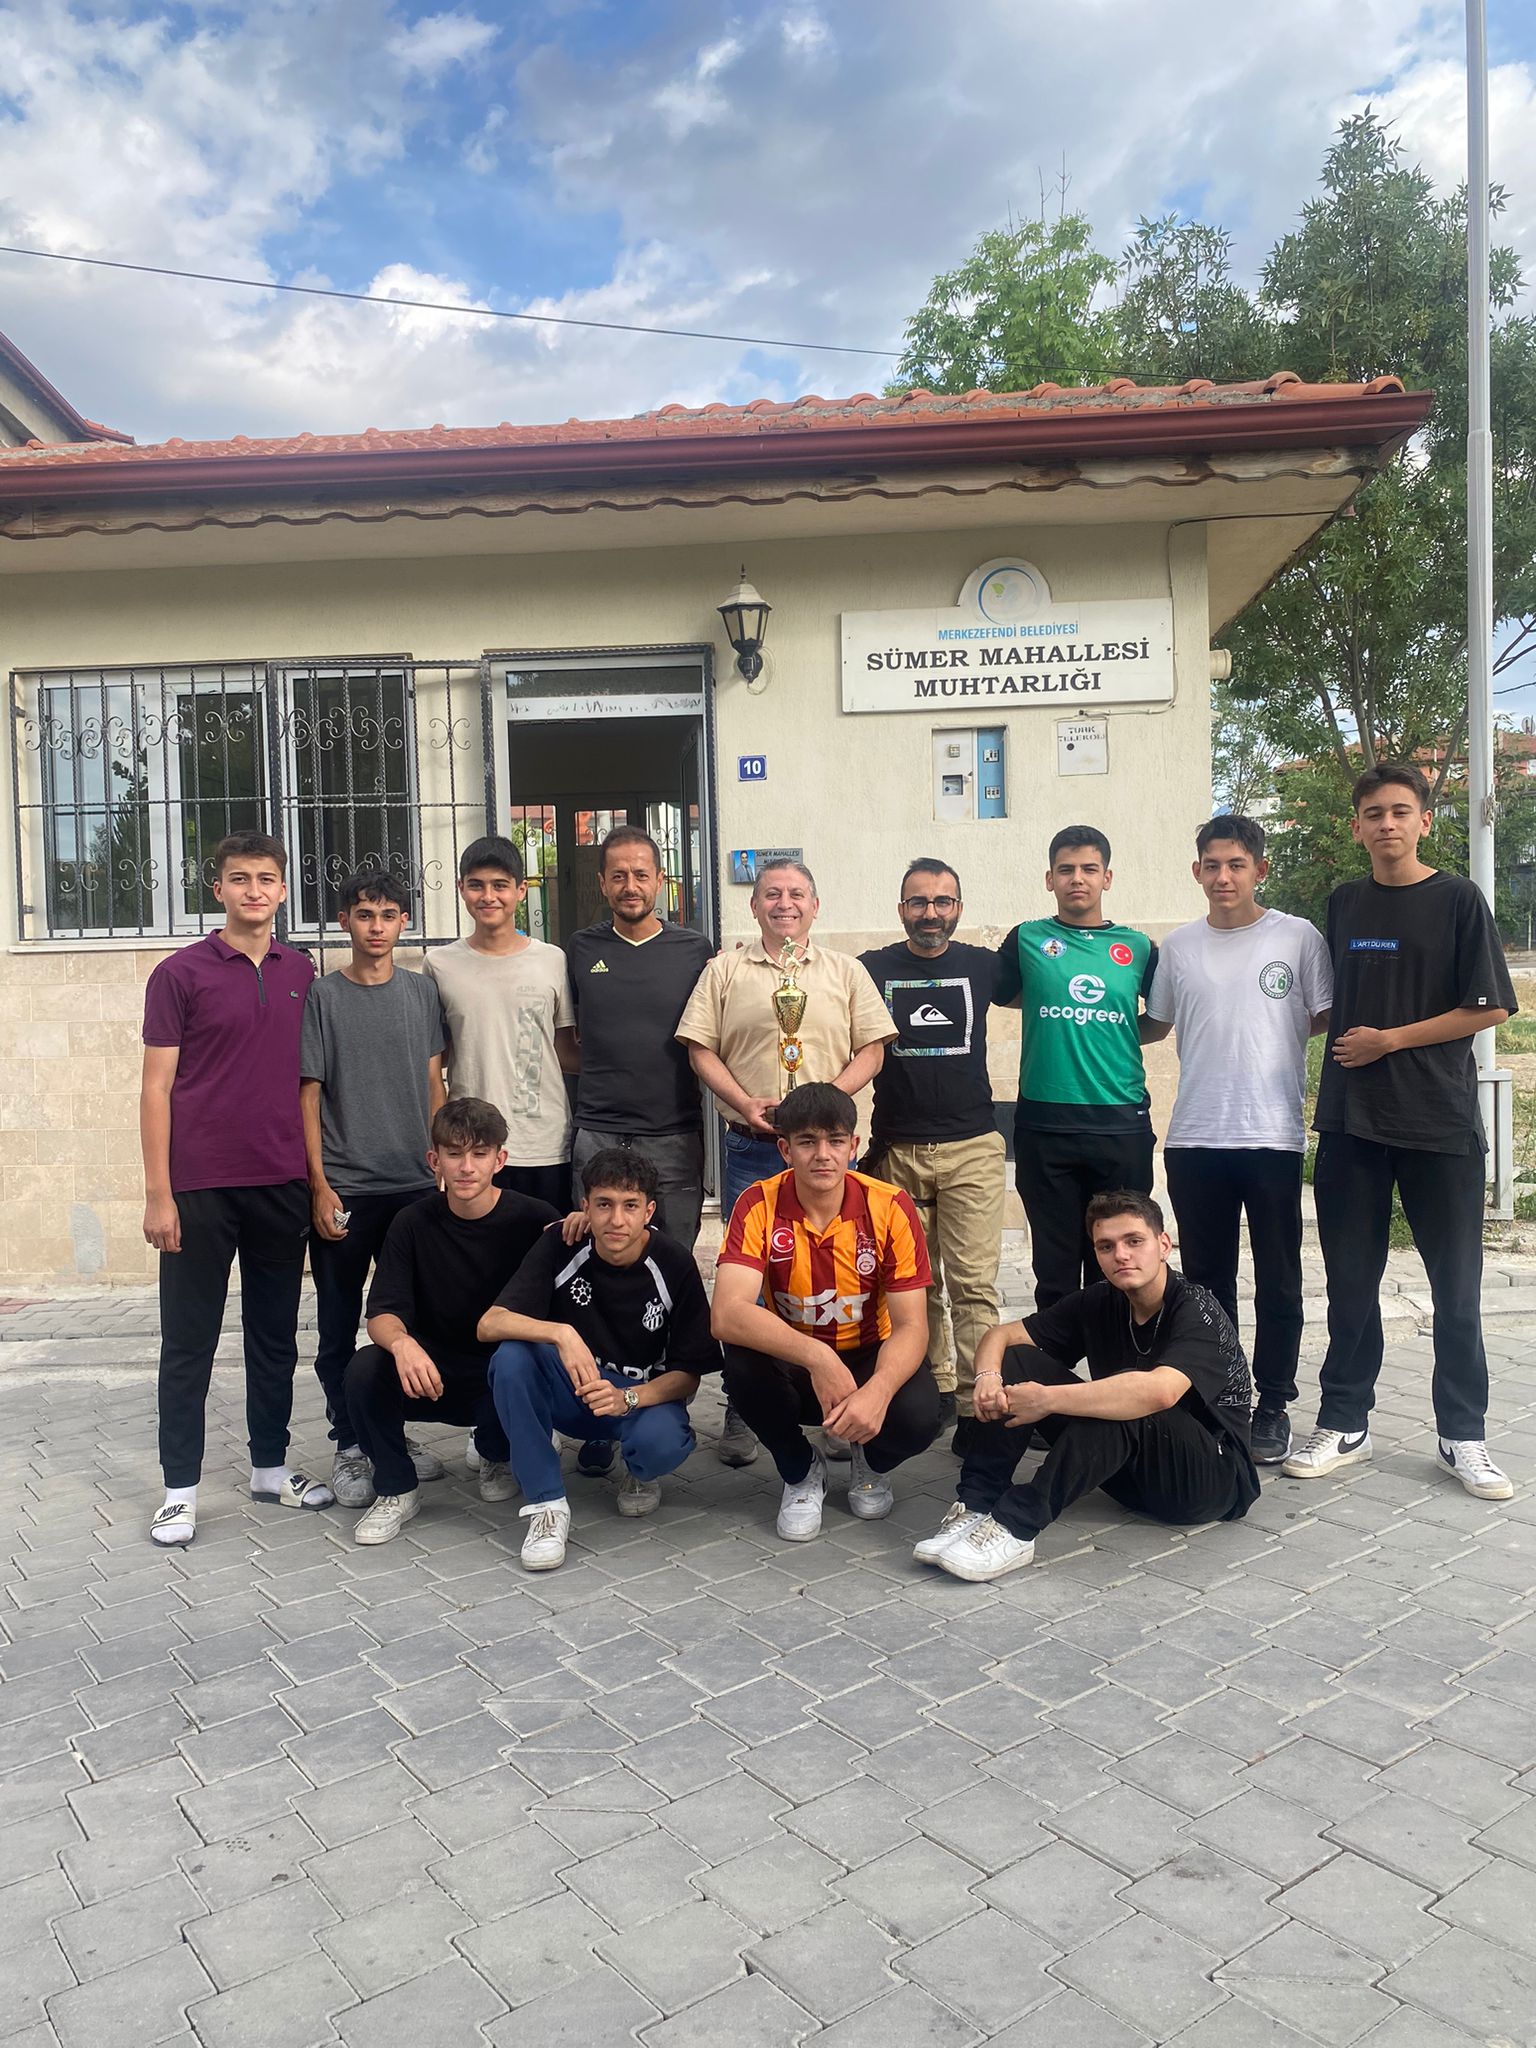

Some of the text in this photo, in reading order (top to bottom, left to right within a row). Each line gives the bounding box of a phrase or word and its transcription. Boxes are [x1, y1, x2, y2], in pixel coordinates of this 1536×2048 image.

[938, 621, 1079, 640] MERKEZEFENDİ BELEDİYESİ
[866, 637, 1150, 671] SÜMER MAHALLESİ
[914, 668, 1102, 697] MUHTARLIĞI
[743, 760, 762, 775] 10
